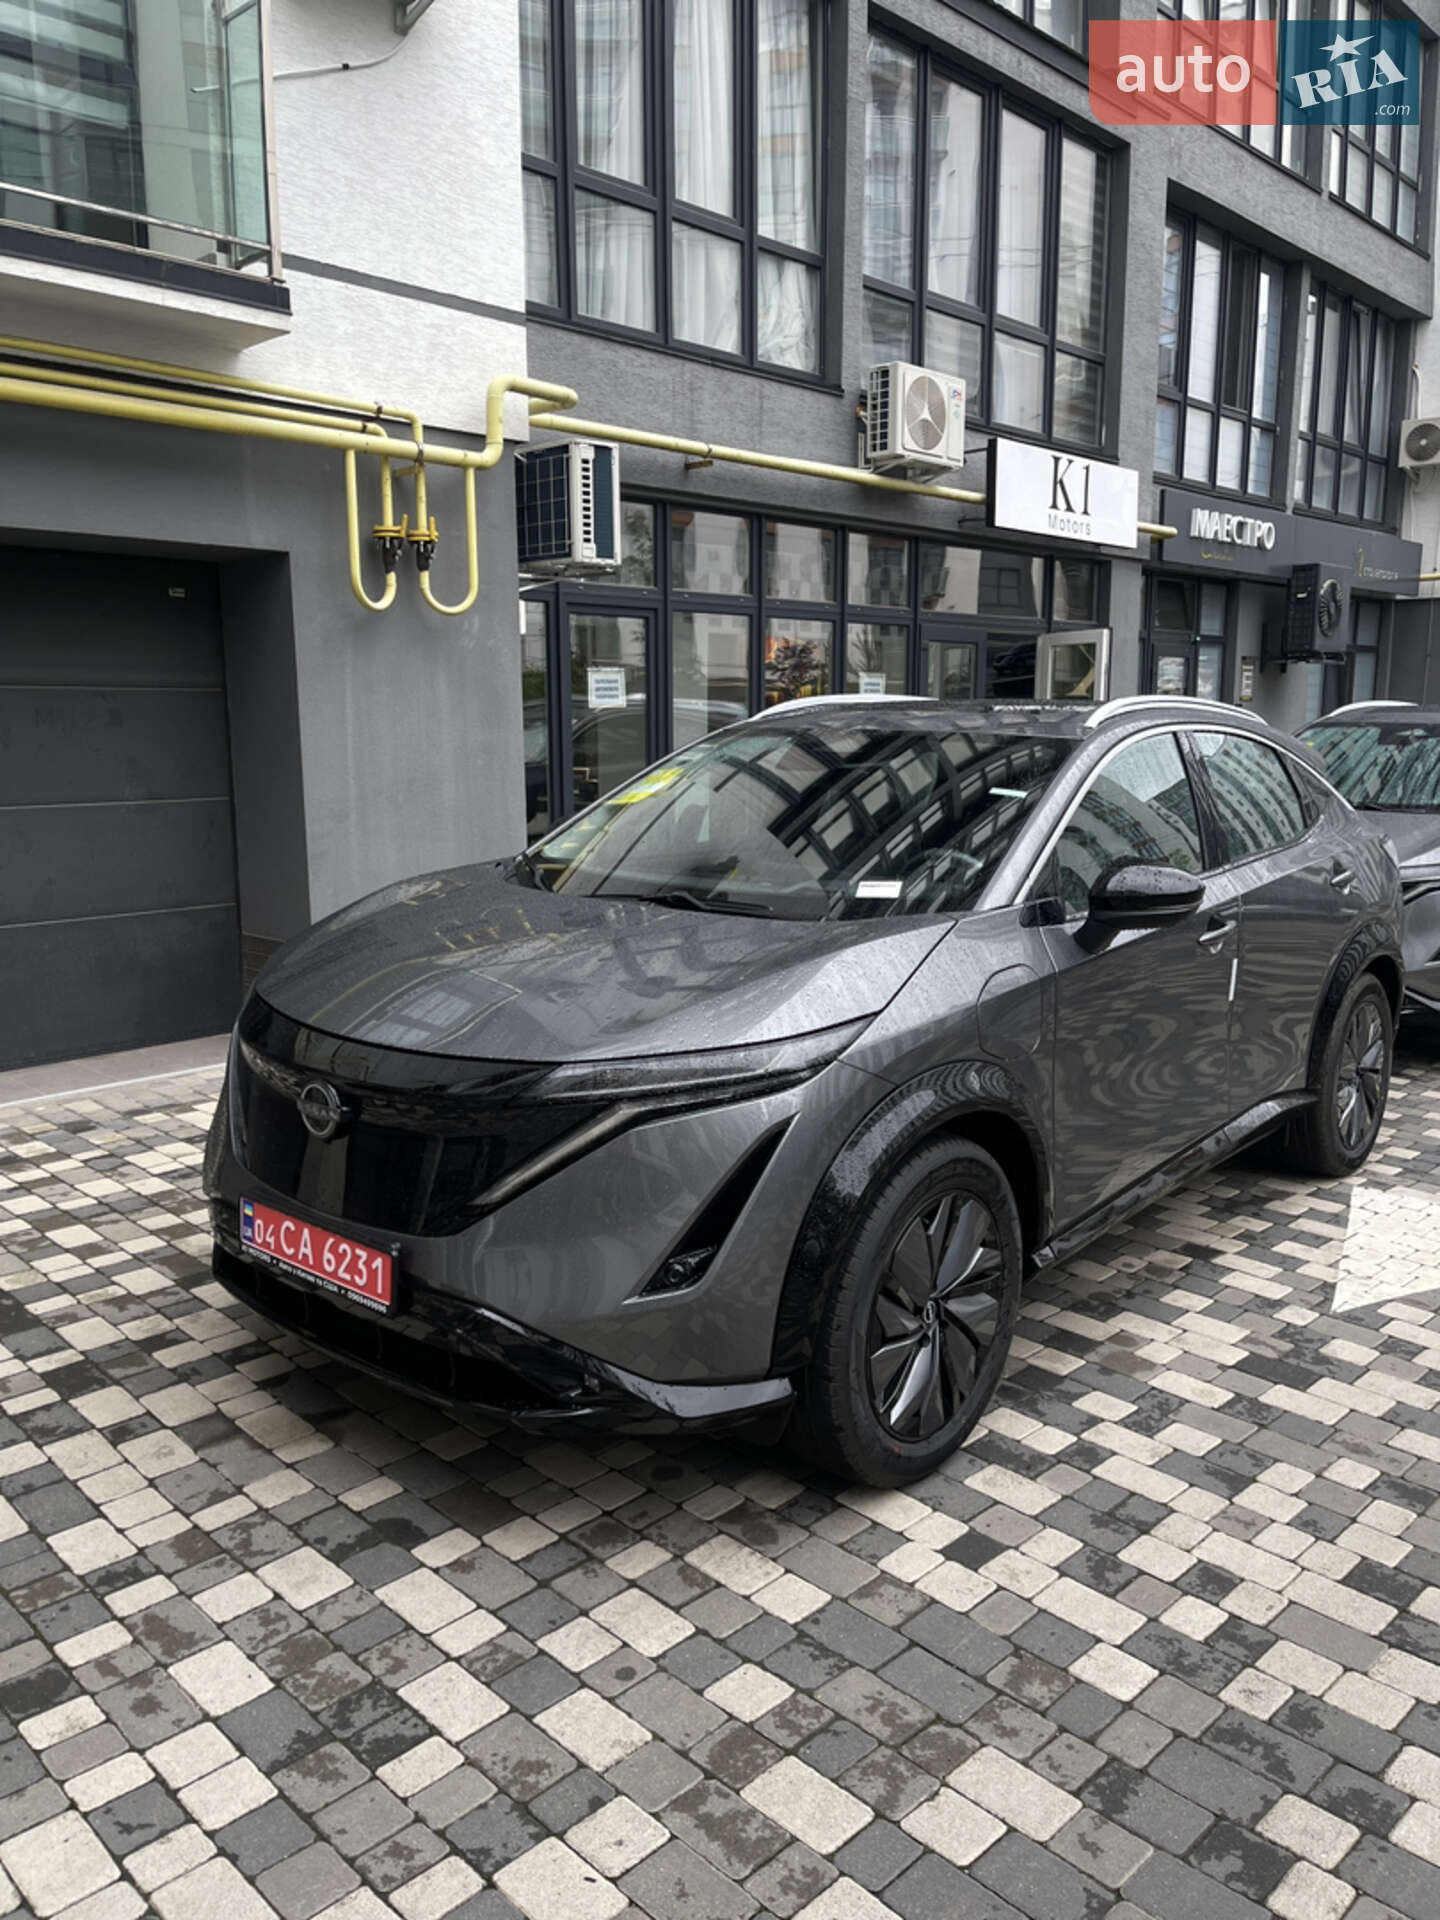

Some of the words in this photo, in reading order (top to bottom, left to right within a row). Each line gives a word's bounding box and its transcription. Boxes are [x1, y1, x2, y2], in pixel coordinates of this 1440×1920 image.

[1048, 454, 1091, 516] K1
[1048, 513, 1092, 536] Motors
[1190, 507, 1276, 550] МАЕСТРО
